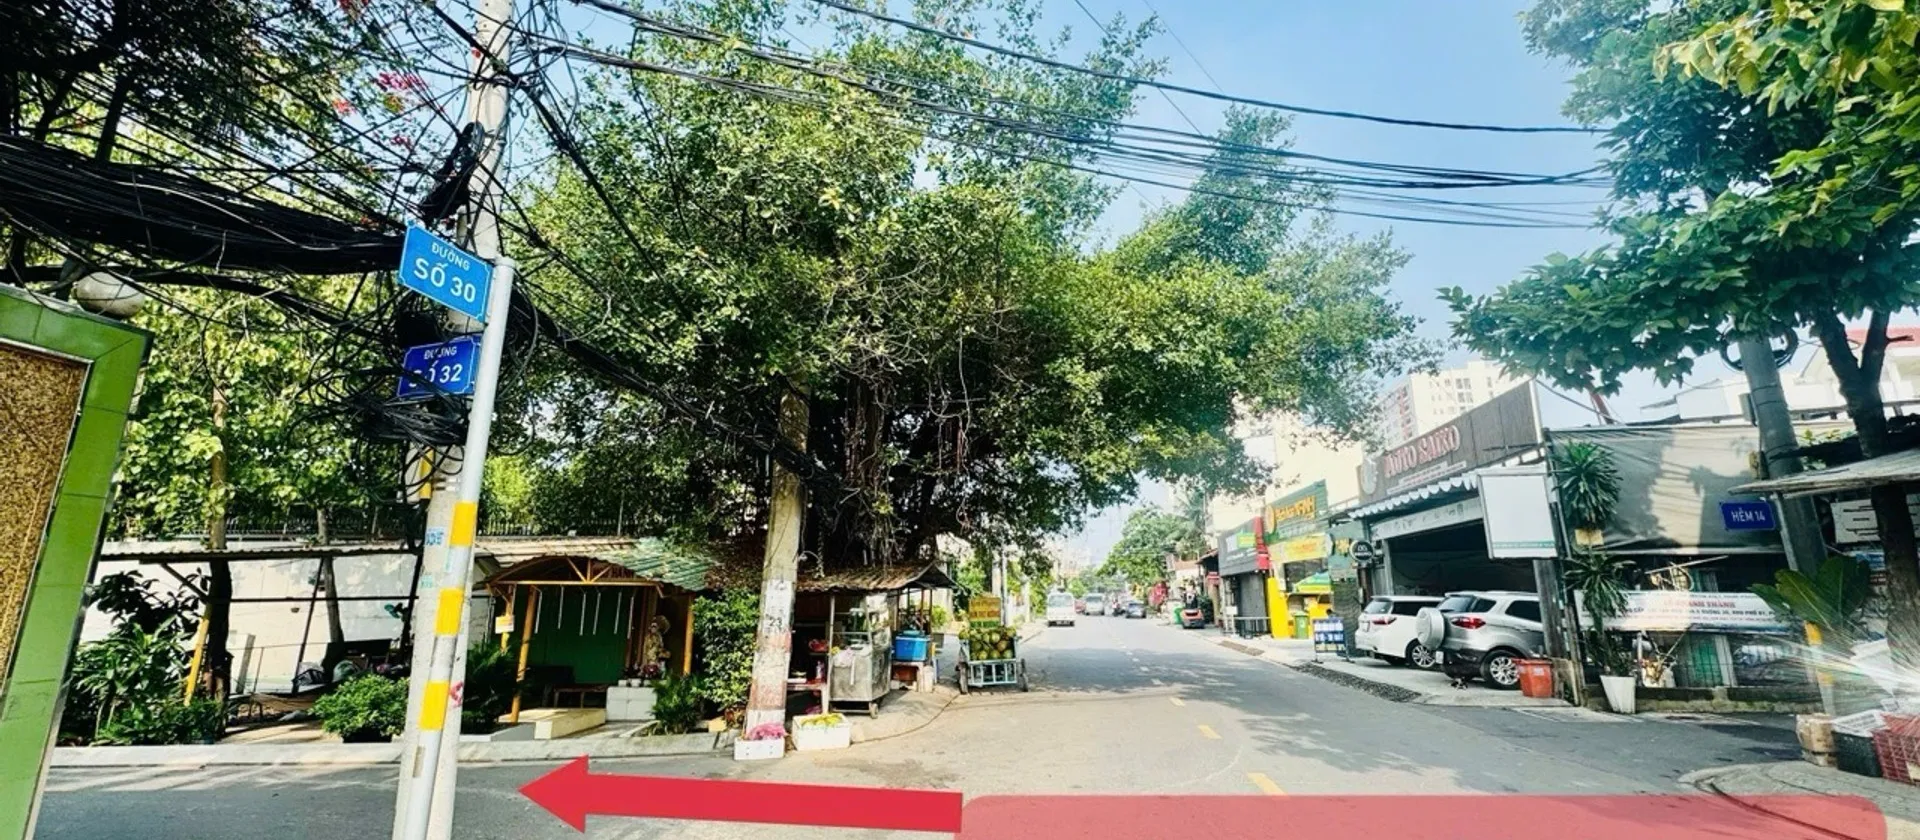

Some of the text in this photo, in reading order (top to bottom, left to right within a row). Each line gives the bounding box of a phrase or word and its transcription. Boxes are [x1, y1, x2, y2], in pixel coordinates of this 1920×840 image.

[431, 242, 470, 271] ĐƯỜNG
[414, 258, 476, 303] SỐ 30
[440, 363, 463, 383] 32
[1384, 445, 1417, 478] AUTO
[1754, 510, 1766, 521] 14
